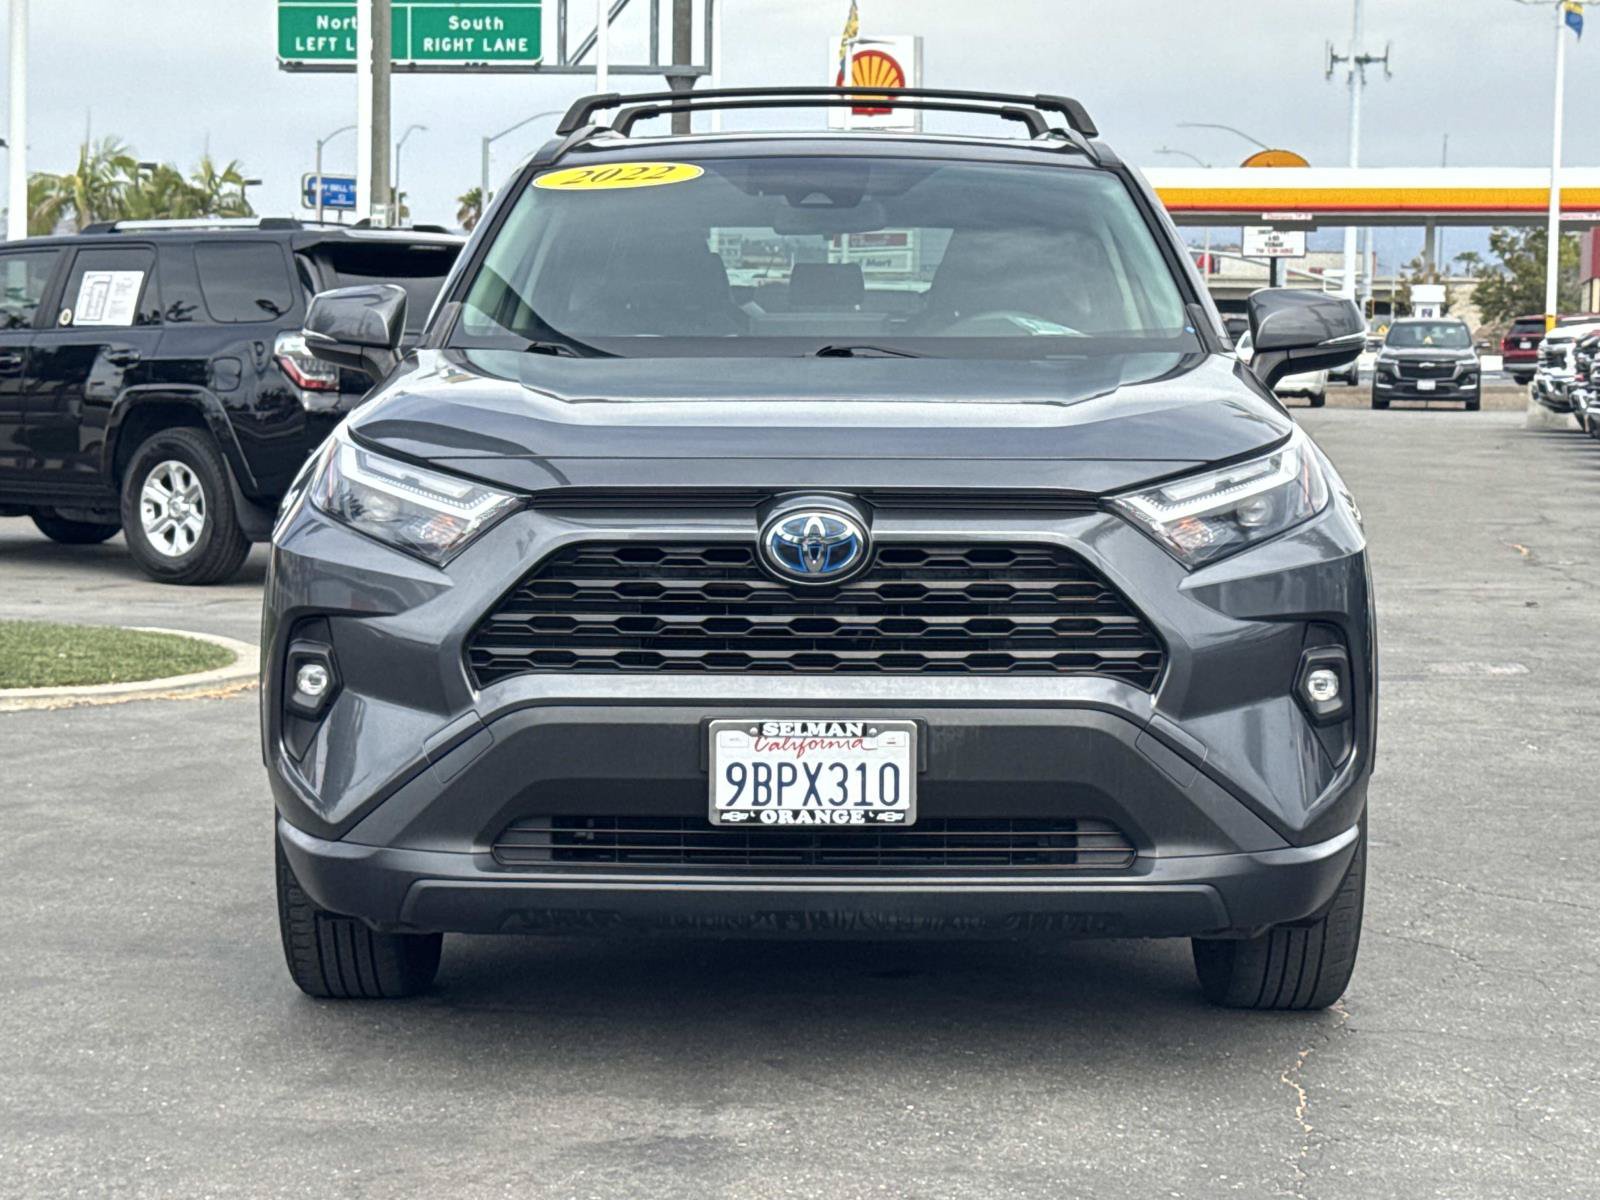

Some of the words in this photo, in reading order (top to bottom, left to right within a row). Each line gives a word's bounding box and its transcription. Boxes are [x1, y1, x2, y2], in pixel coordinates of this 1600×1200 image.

[316, 15, 357, 30] Nort
[448, 15, 504, 30] South
[295, 36, 338, 51] LEFT
[423, 37, 475, 52] RIGHT
[482, 37, 528, 52] LANE
[560, 165, 677, 185] 2022
[762, 722, 864, 737] SELMAN
[754, 735, 878, 759] California
[725, 762, 900, 807] 9BPX310
[759, 810, 866, 825] ORANGE
